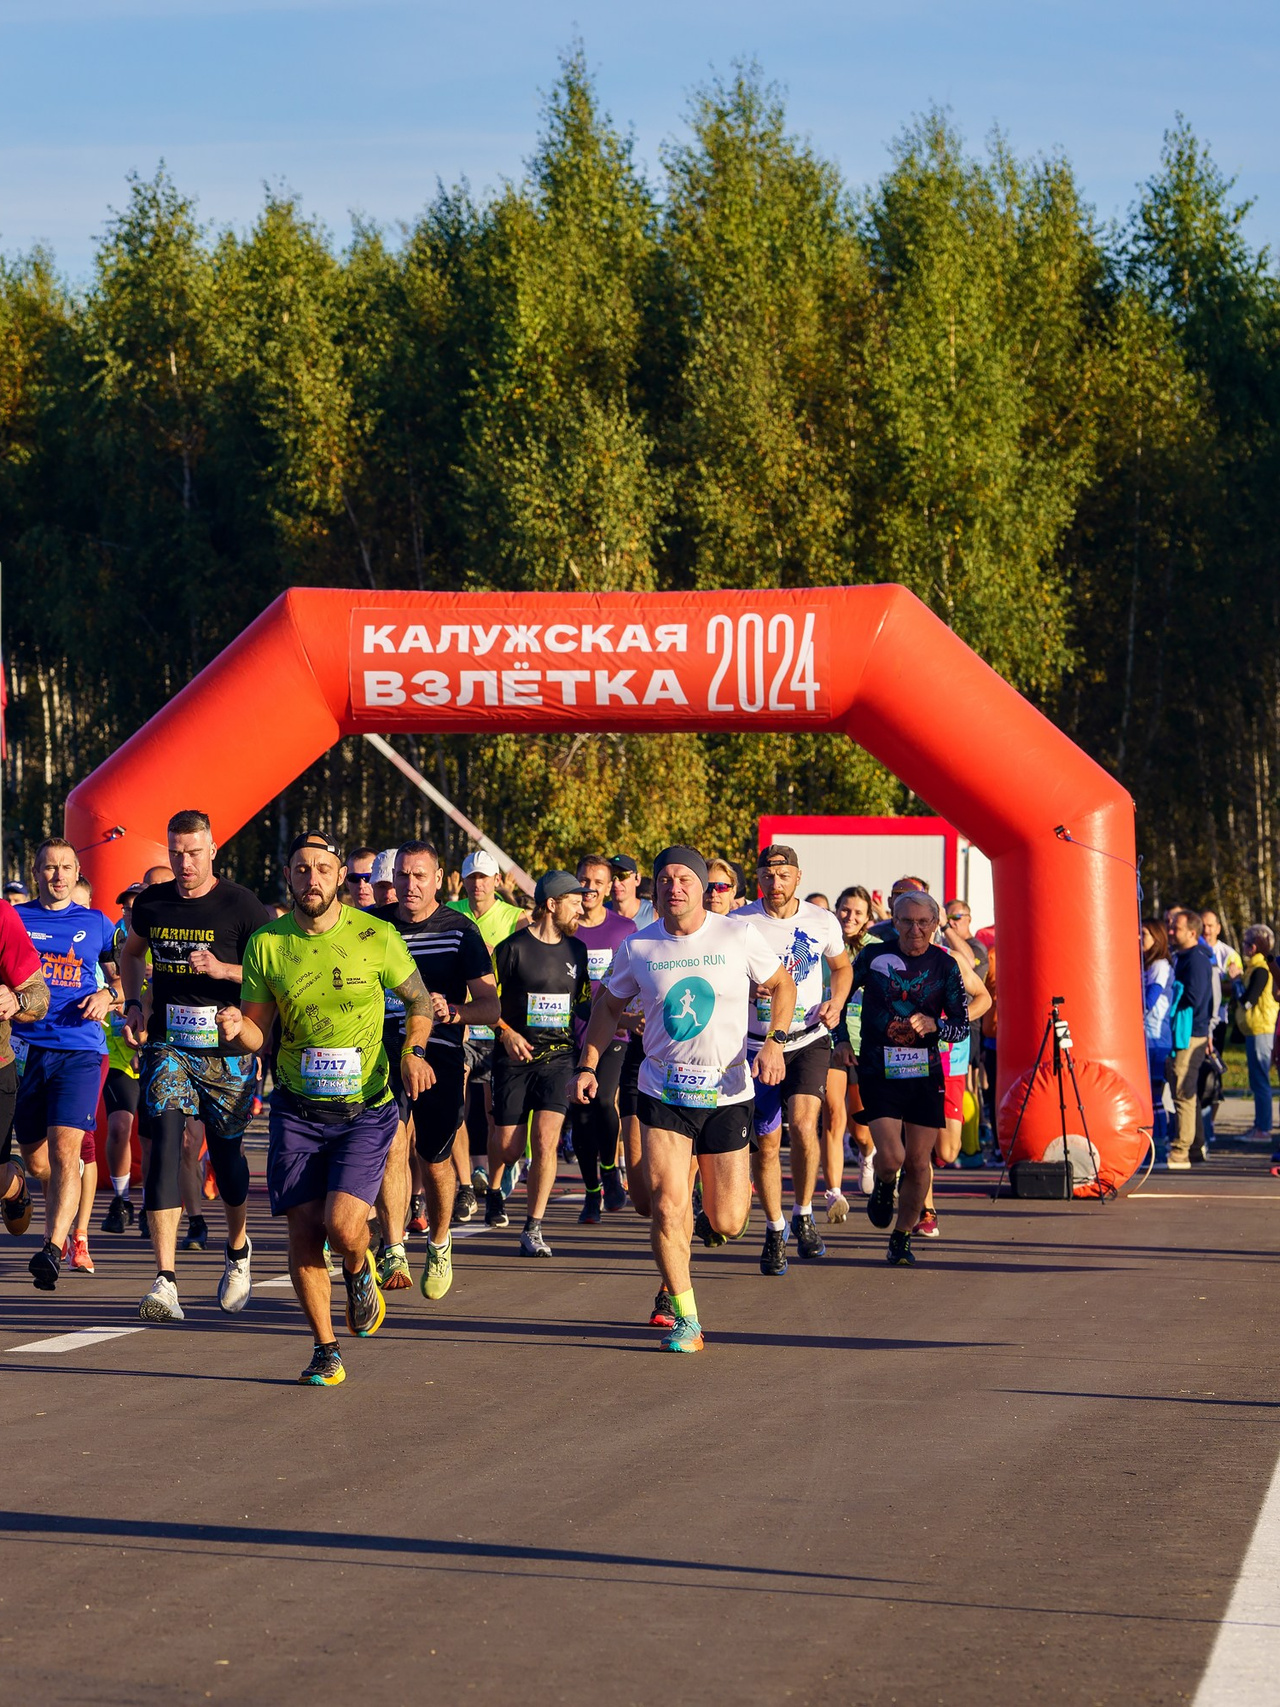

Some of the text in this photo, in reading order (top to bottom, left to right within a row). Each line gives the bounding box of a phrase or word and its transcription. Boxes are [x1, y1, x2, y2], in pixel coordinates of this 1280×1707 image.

[362, 623, 688, 654] КАЛУЖСКАЯ
[706, 612, 820, 712] 2024
[364, 661, 689, 706] ВЗЛЁТКА
[150, 926, 215, 941] WARNING
[646, 954, 726, 972] Товарково RUN
[42, 961, 82, 981] СКВА
[385, 996, 392, 1004] 7
[538, 1002, 563, 1010] 1741
[175, 1015, 208, 1026] 1743
[895, 1052, 919, 1061] 1714
[314, 1059, 347, 1070] 1717
[673, 1073, 707, 1086] 1737
